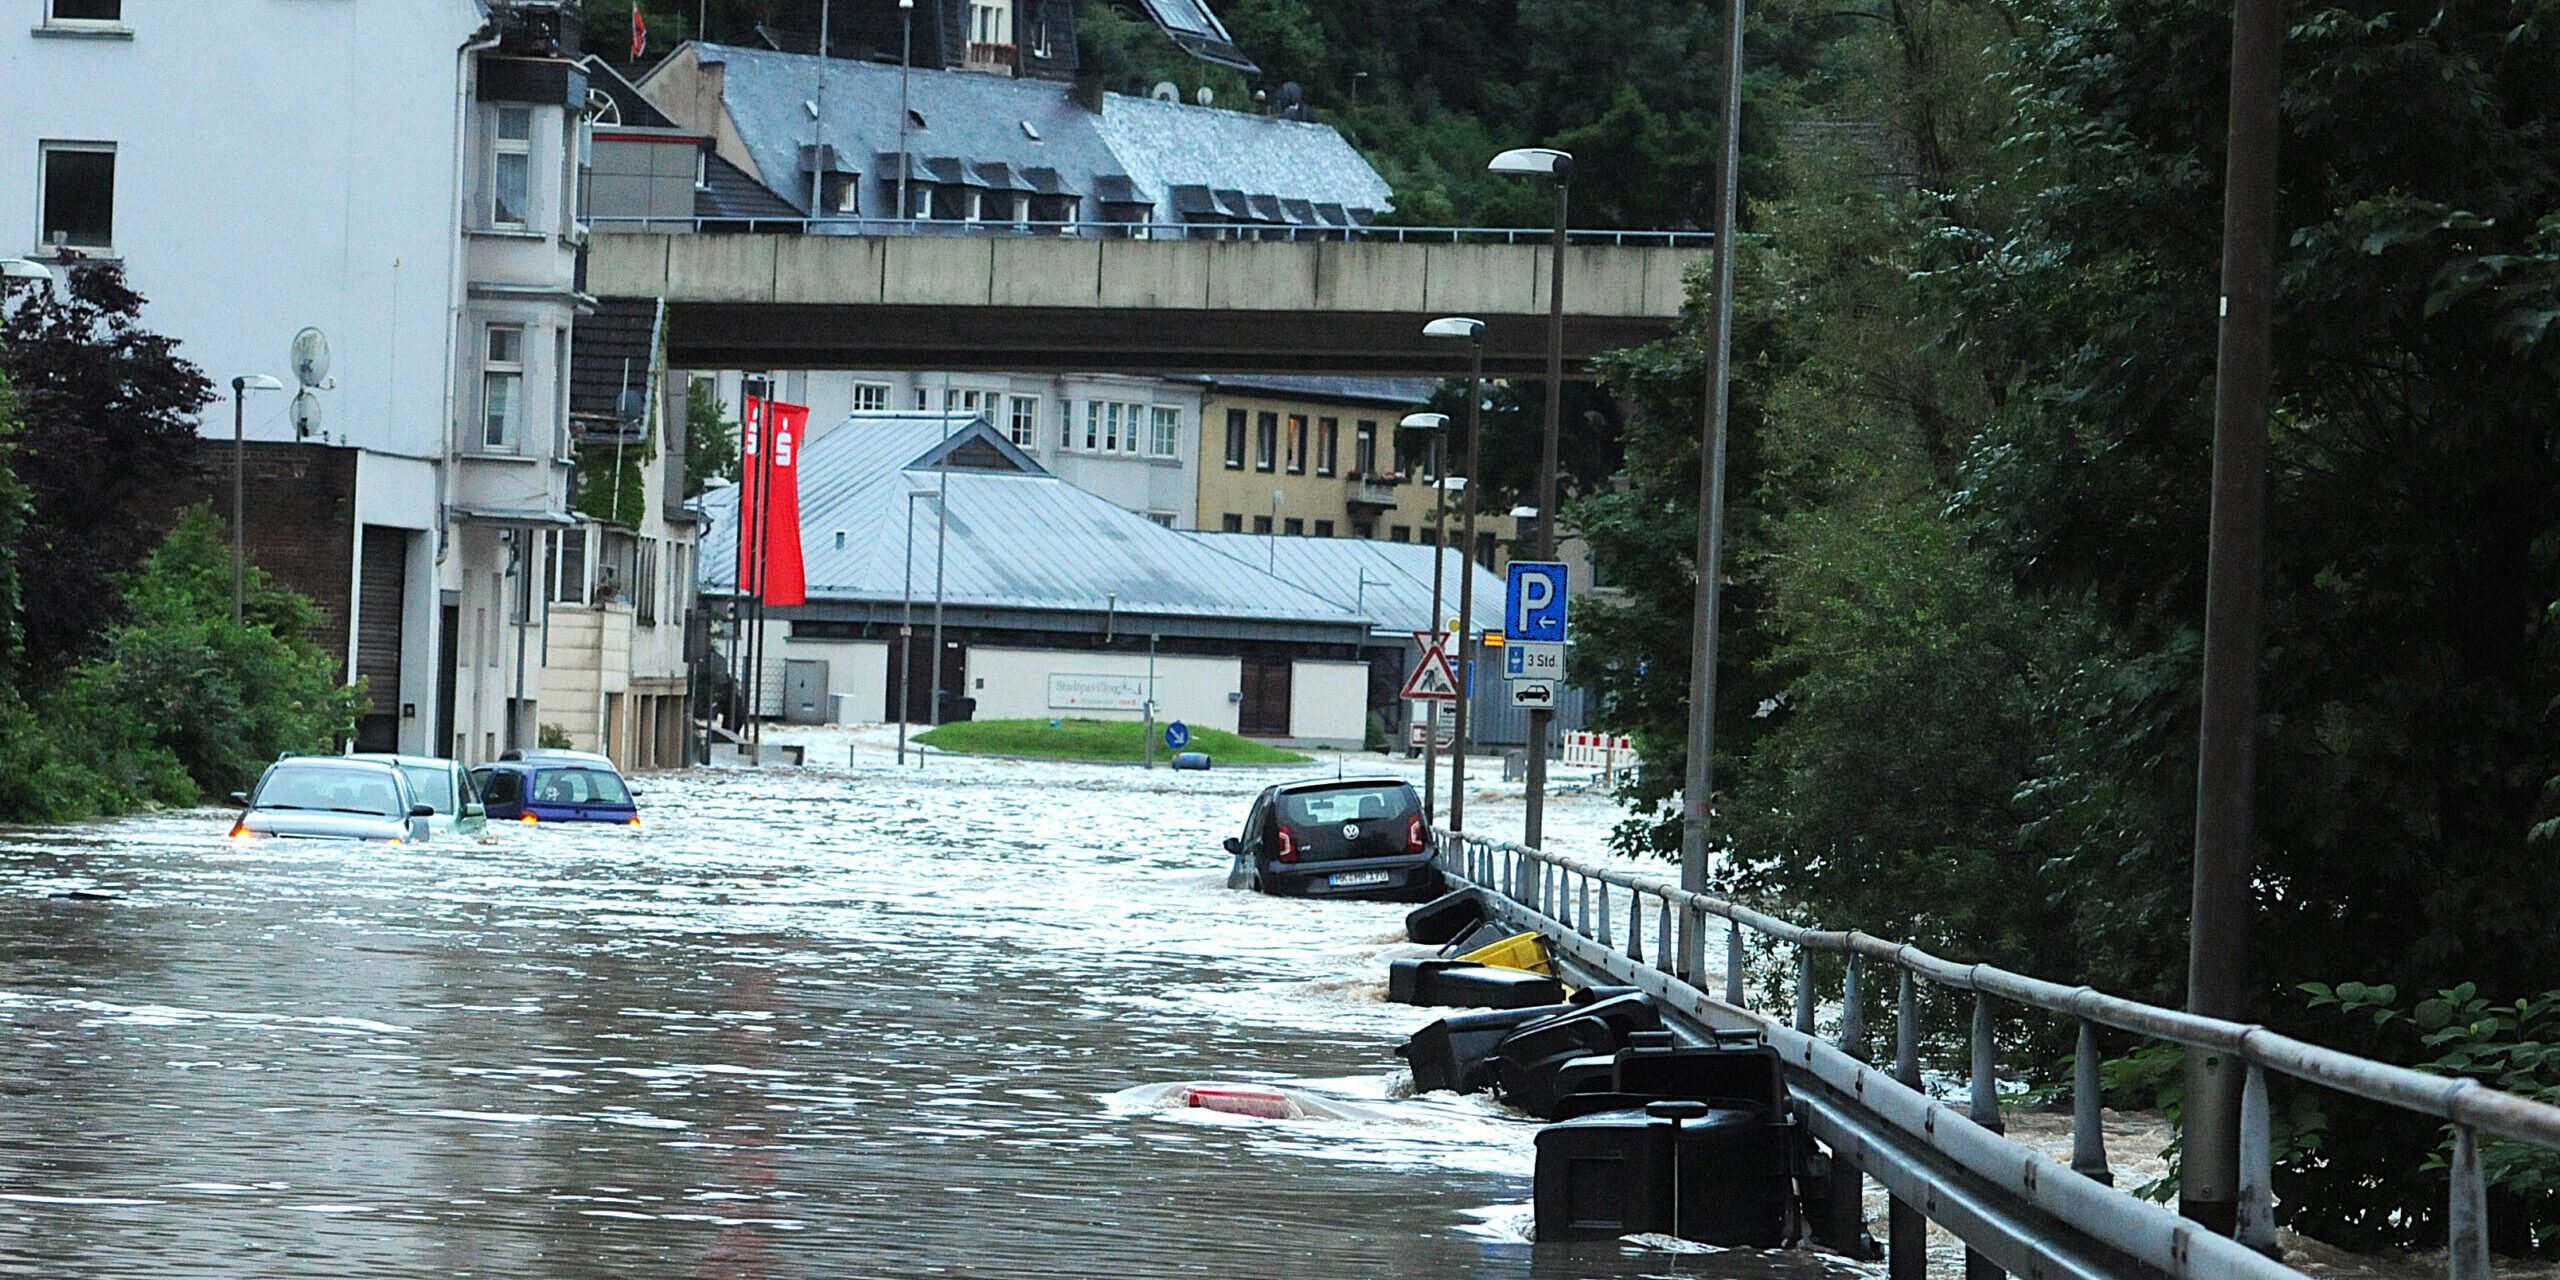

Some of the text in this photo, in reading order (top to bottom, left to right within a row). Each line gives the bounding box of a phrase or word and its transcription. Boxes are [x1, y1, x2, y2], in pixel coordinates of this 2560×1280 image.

[1519, 572, 1553, 632] P
[1527, 654, 1558, 668] 3 Std.
